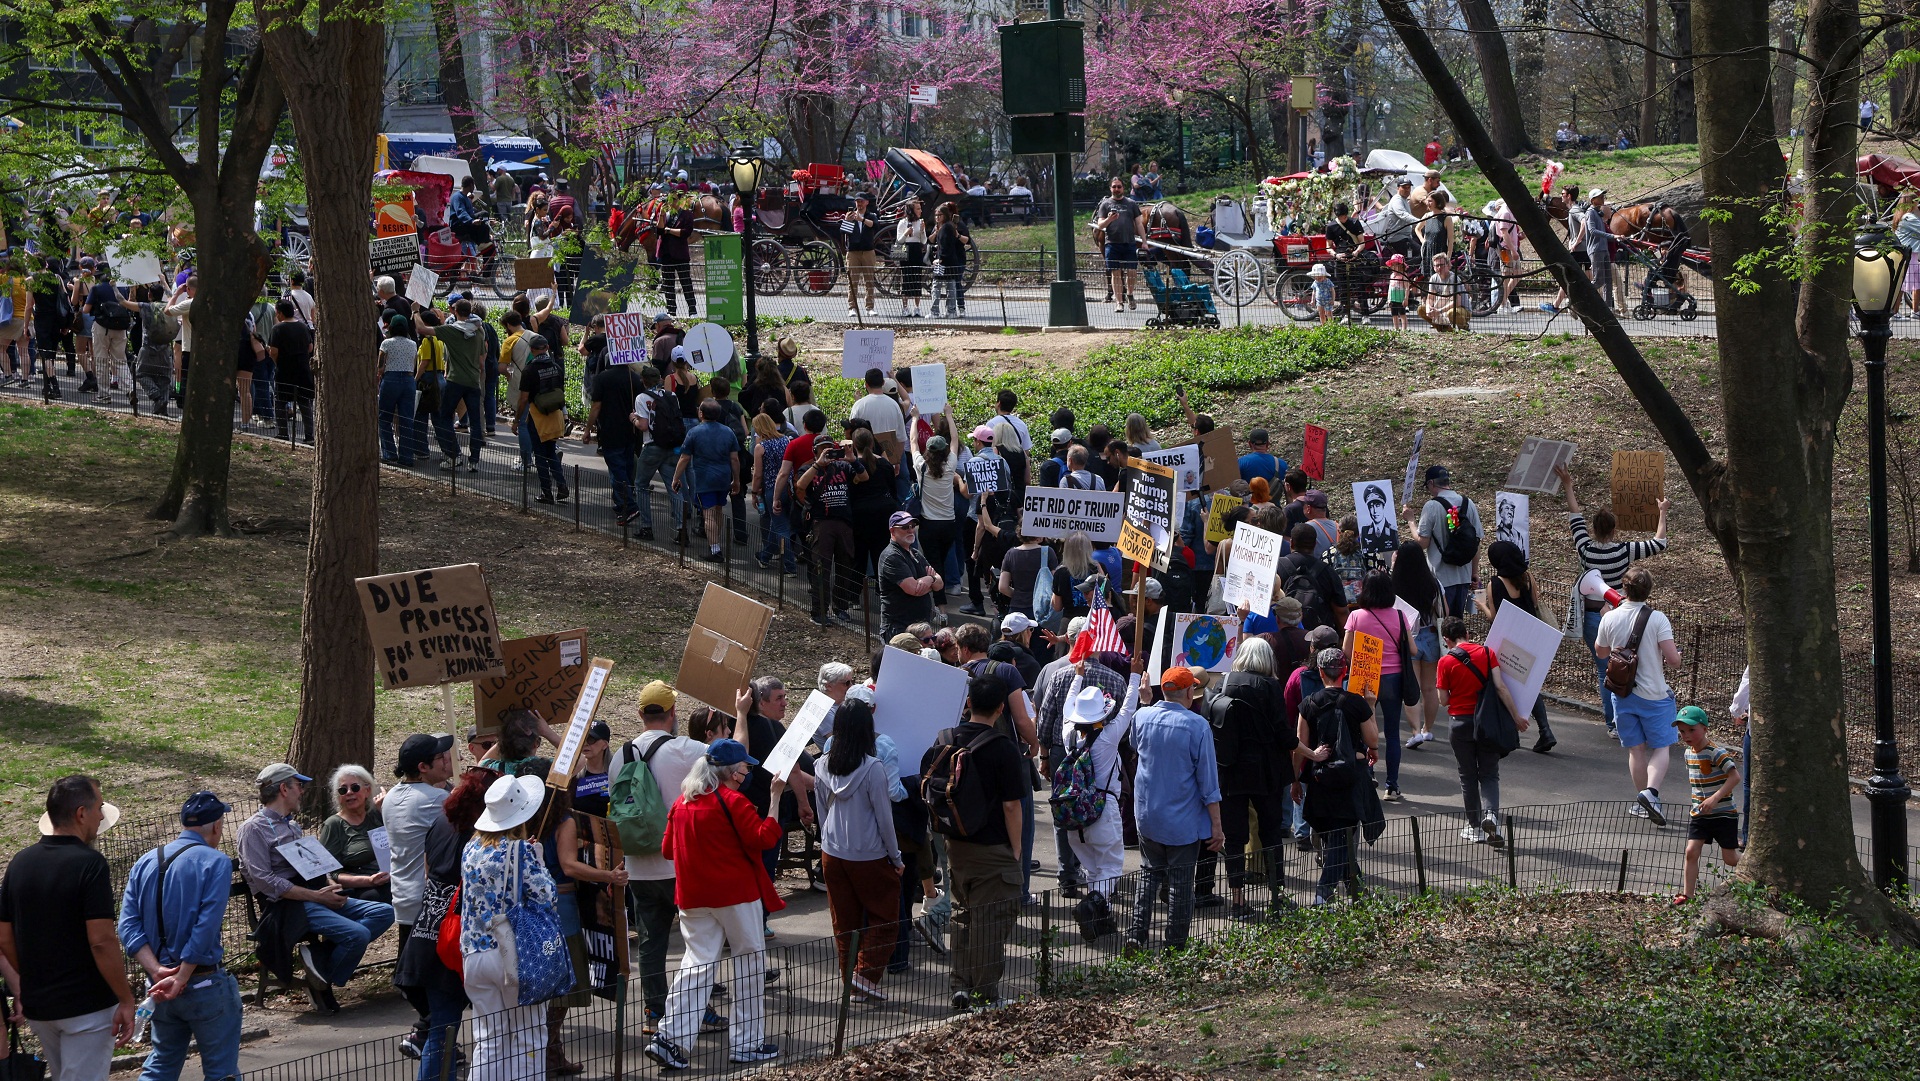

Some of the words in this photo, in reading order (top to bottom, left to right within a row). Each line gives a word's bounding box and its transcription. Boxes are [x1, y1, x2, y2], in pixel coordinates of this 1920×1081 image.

[383, 224, 409, 232] RESIST
[378, 244, 406, 252] DIFFERENCE
[396, 246, 416, 254] OPINION
[388, 254, 418, 264] DIFFERENCE
[604, 313, 641, 338] RESIST
[608, 339, 614, 352] IF
[615, 337, 630, 352] NOT
[631, 336, 645, 350] NOW
[610, 349, 647, 364] WHEN?
[1308, 428, 1323, 436] STOP
[1308, 435, 1319, 443] THE
[966, 460, 1000, 472] PROTECT
[1618, 453, 1658, 468] MAKE
[972, 471, 998, 482] TRANS
[1142, 473, 1154, 483] The
[1614, 467, 1660, 480] AMERICA
[976, 481, 998, 493] LIVES
[1132, 479, 1167, 500] Trump
[1616, 480, 1659, 493] GREATER
[1025, 496, 1045, 512] GET
[1047, 498, 1065, 514] RID
[1068, 500, 1081, 515] OF
[1084, 501, 1120, 518] TRUMP
[1129, 492, 1168, 514] Fascist
[1630, 505, 1645, 513] THE
[1033, 517, 1050, 528] AND
[1053, 519, 1066, 529] HIS
[1069, 520, 1105, 532] CRONIES
[1127, 505, 1168, 528] Regime
[1617, 514, 1659, 530] TRAITO
[1124, 525, 1140, 542] MUST
[1141, 535, 1152, 549] GO
[1240, 528, 1274, 553] TRUMP'S
[1121, 538, 1148, 560] NOW!!!
[1233, 544, 1258, 565] MIGRANT
[1259, 553, 1273, 569] PATH
[368, 570, 438, 613] DUE
[400, 605, 489, 634] PROCESS
[1178, 615, 1200, 623] EARTH
[384, 640, 414, 669] FOR
[418, 633, 495, 659] EVERYONE
[478, 635, 560, 699] LOGGING
[388, 667, 409, 685] NO
[514, 671, 539, 695] ON
[497, 656, 583, 722] PROTECTED
